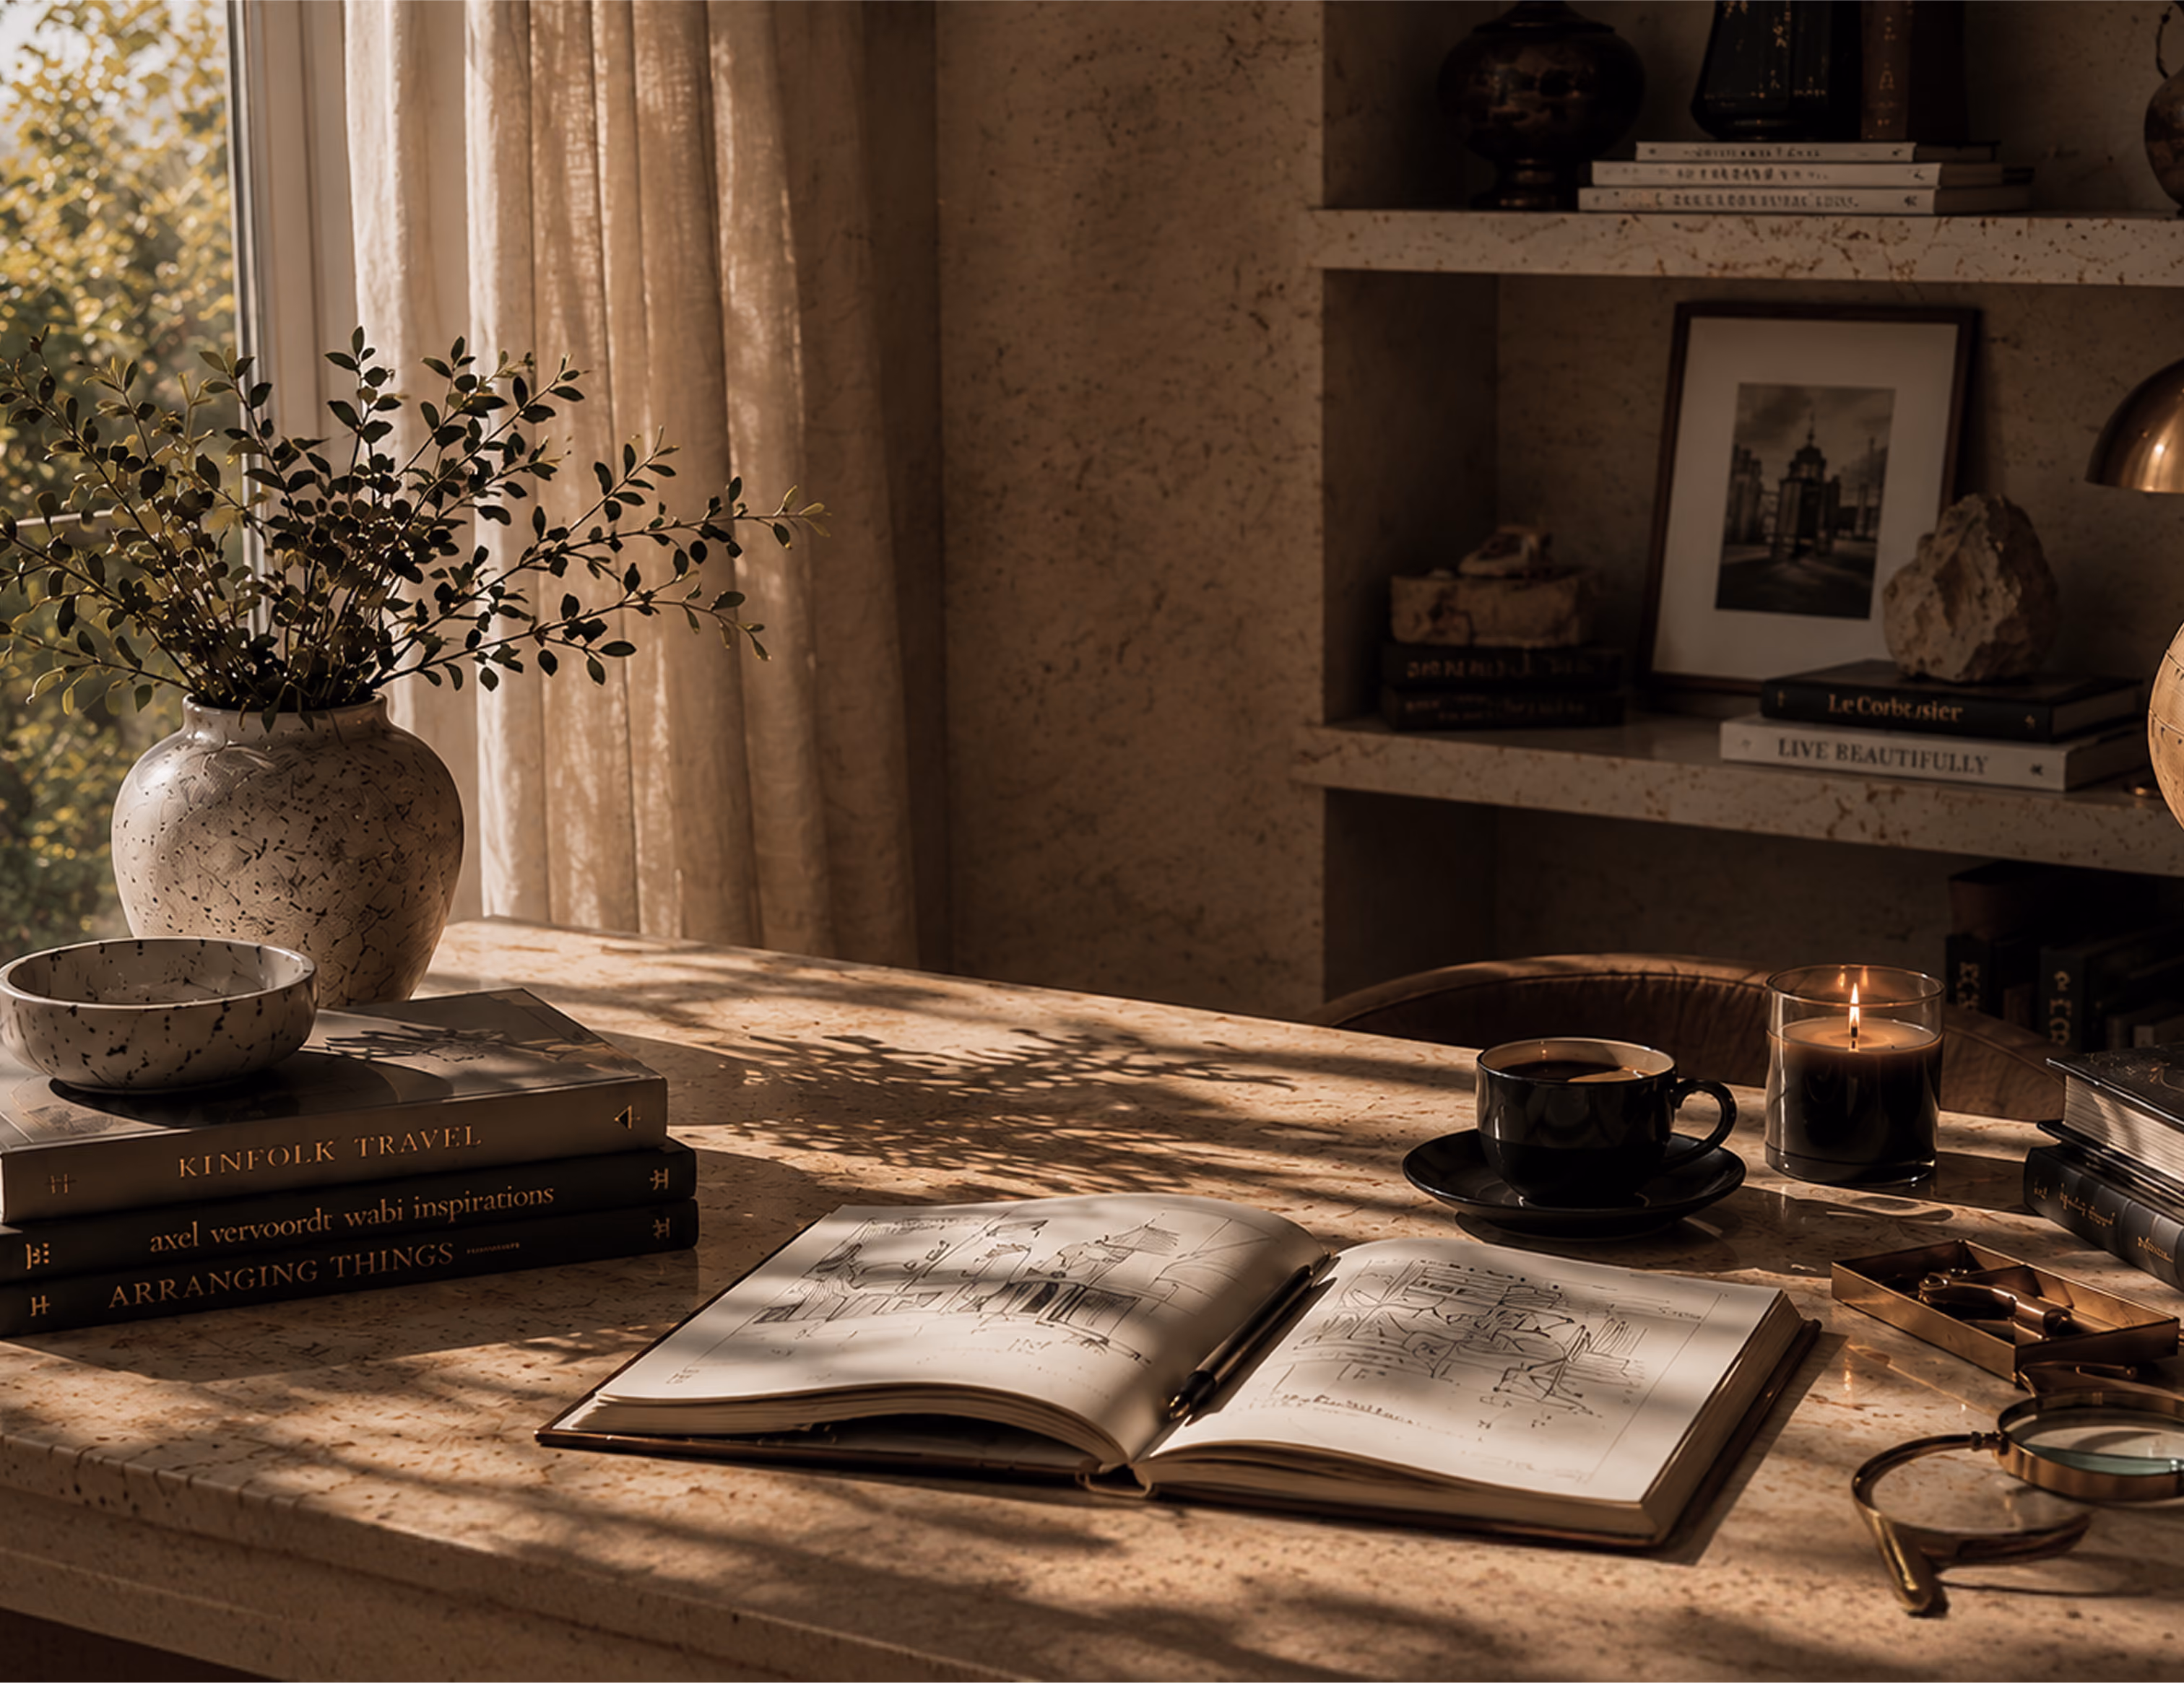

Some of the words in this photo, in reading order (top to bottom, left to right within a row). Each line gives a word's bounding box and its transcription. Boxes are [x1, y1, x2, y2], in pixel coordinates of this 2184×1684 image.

[1777, 738, 1829, 760] LIVE
[1835, 742, 1990, 776] BEAUTIFULLY
[178, 1140, 336, 1179] KINFOLK
[353, 1125, 482, 1158] TRAVEL
[150, 1220, 199, 1253] axel
[209, 1207, 333, 1244] vervoordt
[343, 1198, 404, 1227] wabi
[413, 1185, 555, 1224] inspirations
[108, 1259, 318, 1309] ARRANGING
[329, 1242, 454, 1279] THINGS
